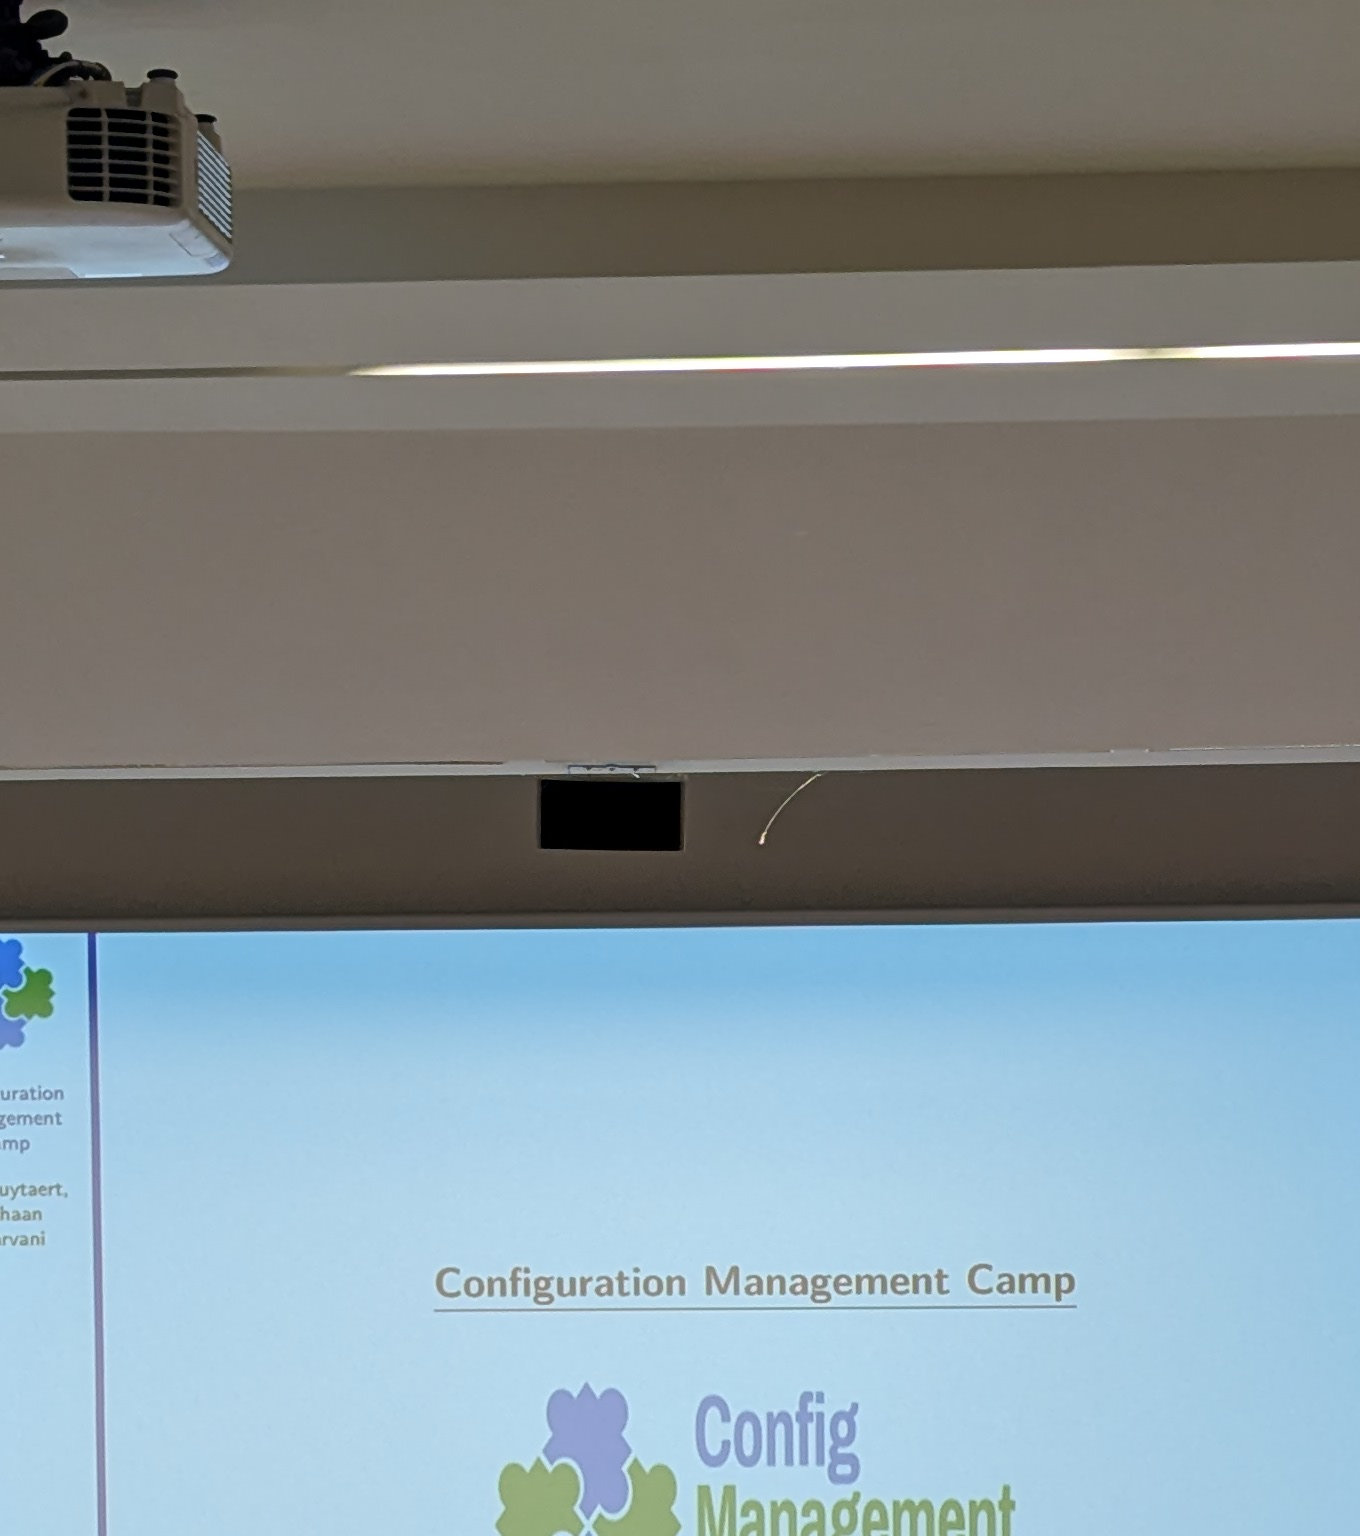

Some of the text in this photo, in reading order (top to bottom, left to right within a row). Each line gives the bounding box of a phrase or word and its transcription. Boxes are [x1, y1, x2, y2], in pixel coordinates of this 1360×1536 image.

[435, 1263, 1076, 1305] Configuration Management Camp
[695, 1390, 861, 1485] Config
